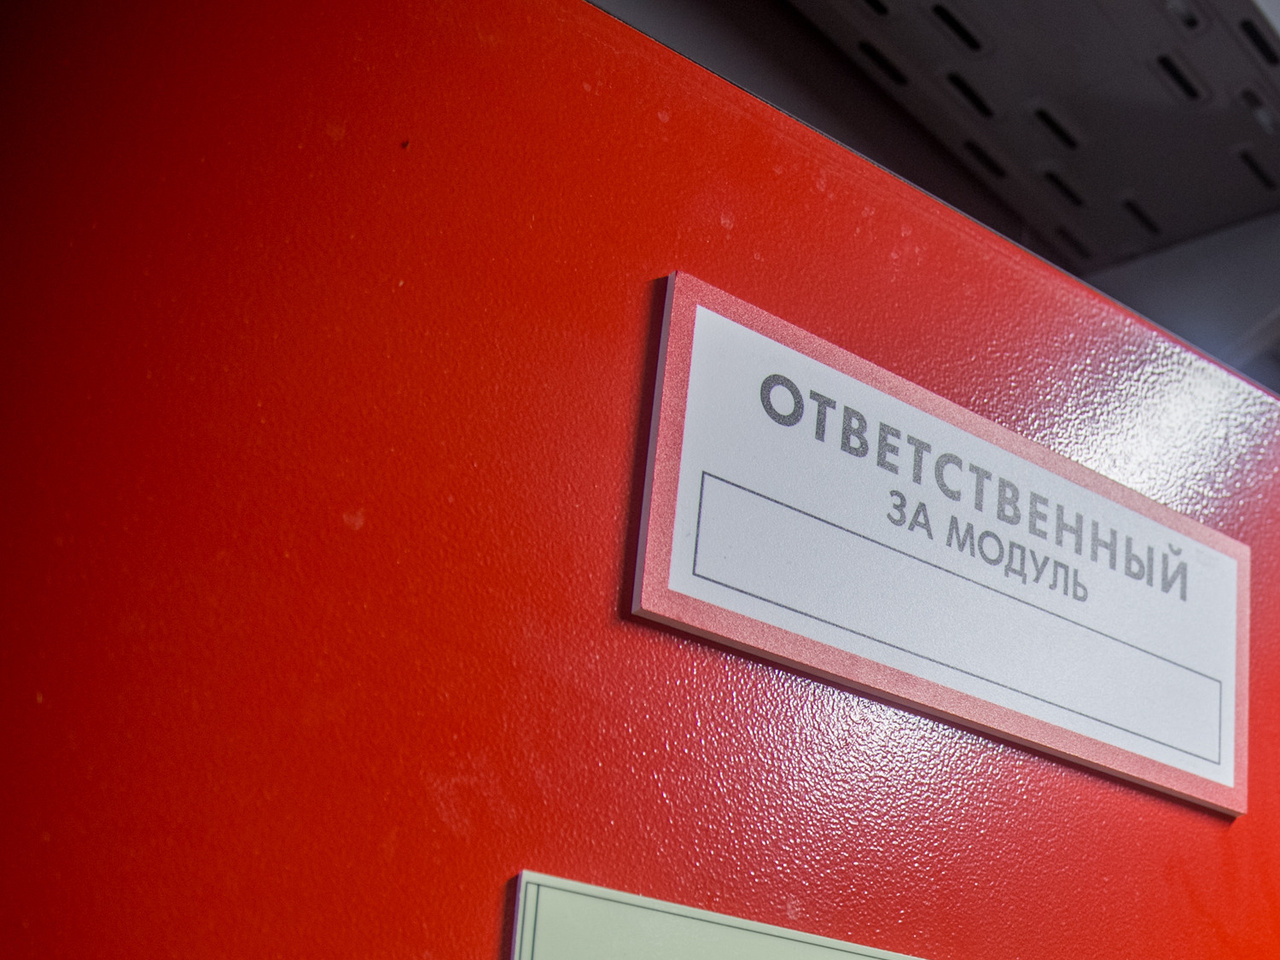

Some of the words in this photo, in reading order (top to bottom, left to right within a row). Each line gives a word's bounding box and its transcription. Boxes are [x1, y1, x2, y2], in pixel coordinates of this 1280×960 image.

[760, 373, 1188, 600] ОТВЕТСТВЕННЫЙ
[887, 490, 933, 540] ЗА
[946, 521, 1088, 601] МОДУЛЬ
